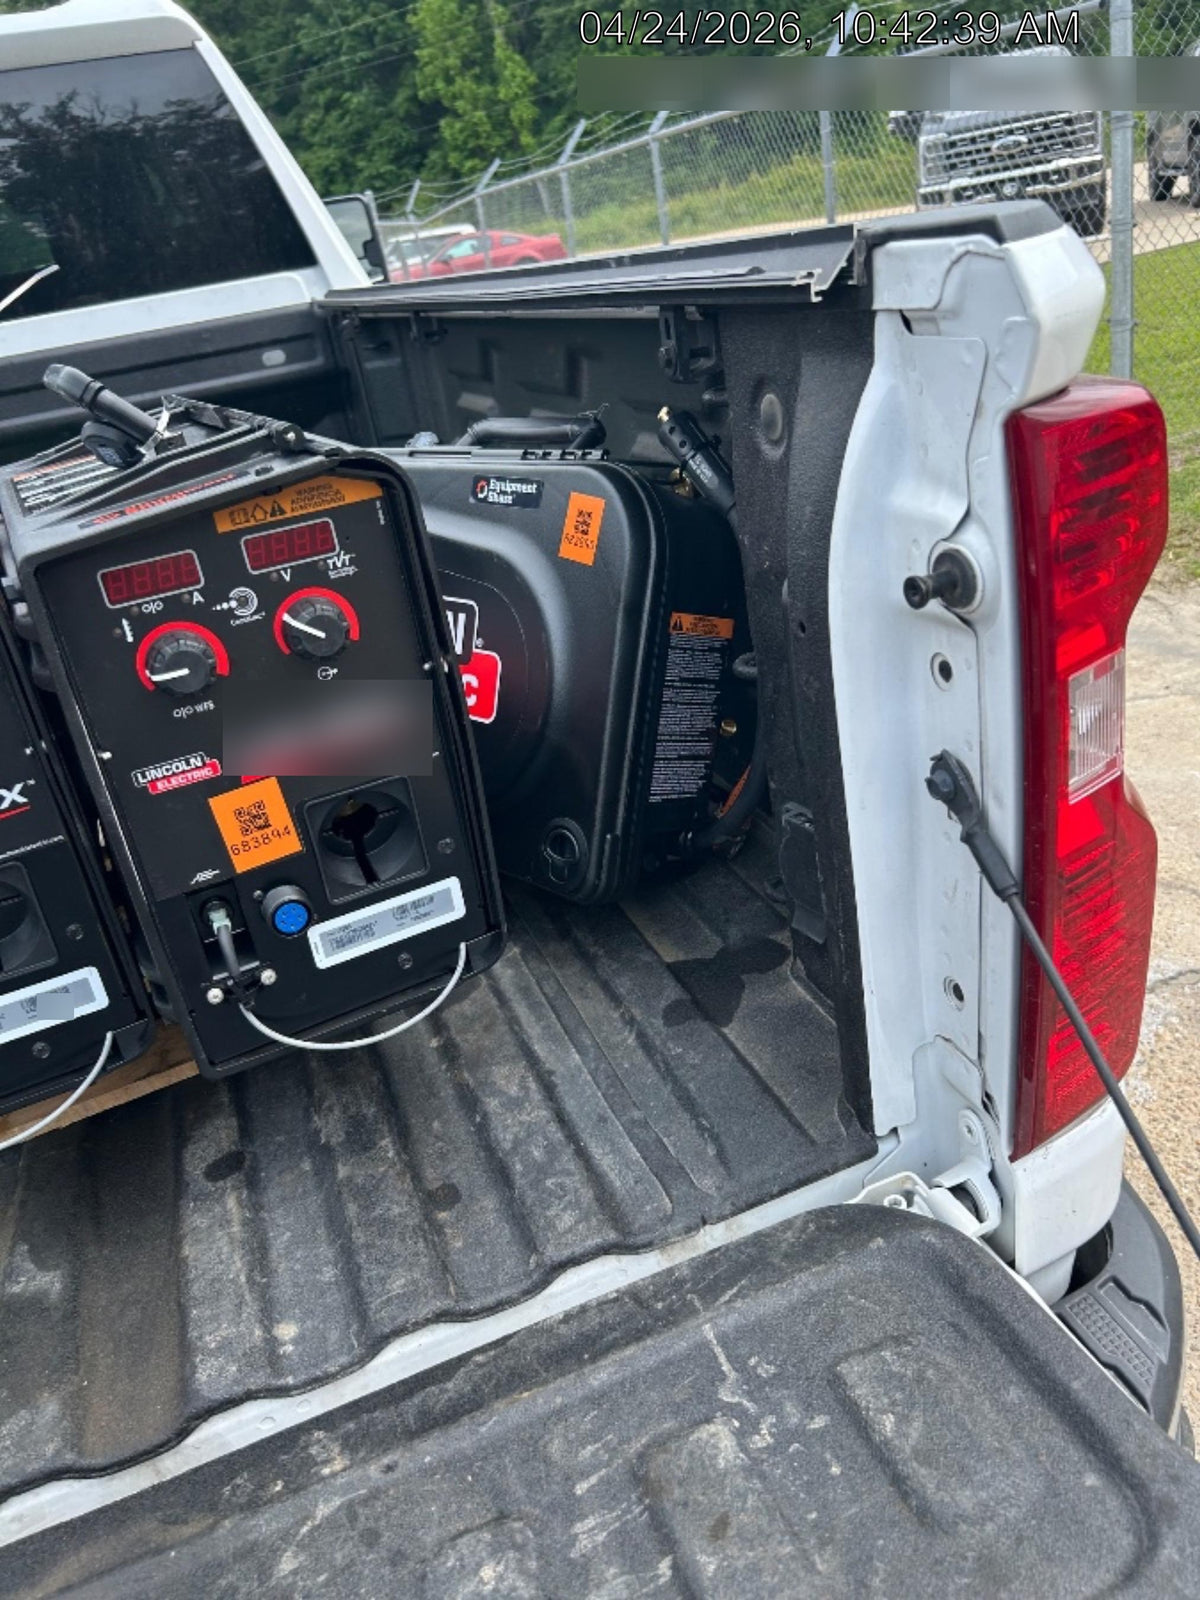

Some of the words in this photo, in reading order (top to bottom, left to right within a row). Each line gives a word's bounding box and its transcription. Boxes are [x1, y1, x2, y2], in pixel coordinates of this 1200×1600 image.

[192, 591, 205, 605] A
[137, 755, 203, 784] LINCOLN
[156, 767, 214, 791] ELECTRIC
[230, 825, 292, 856] 683894
